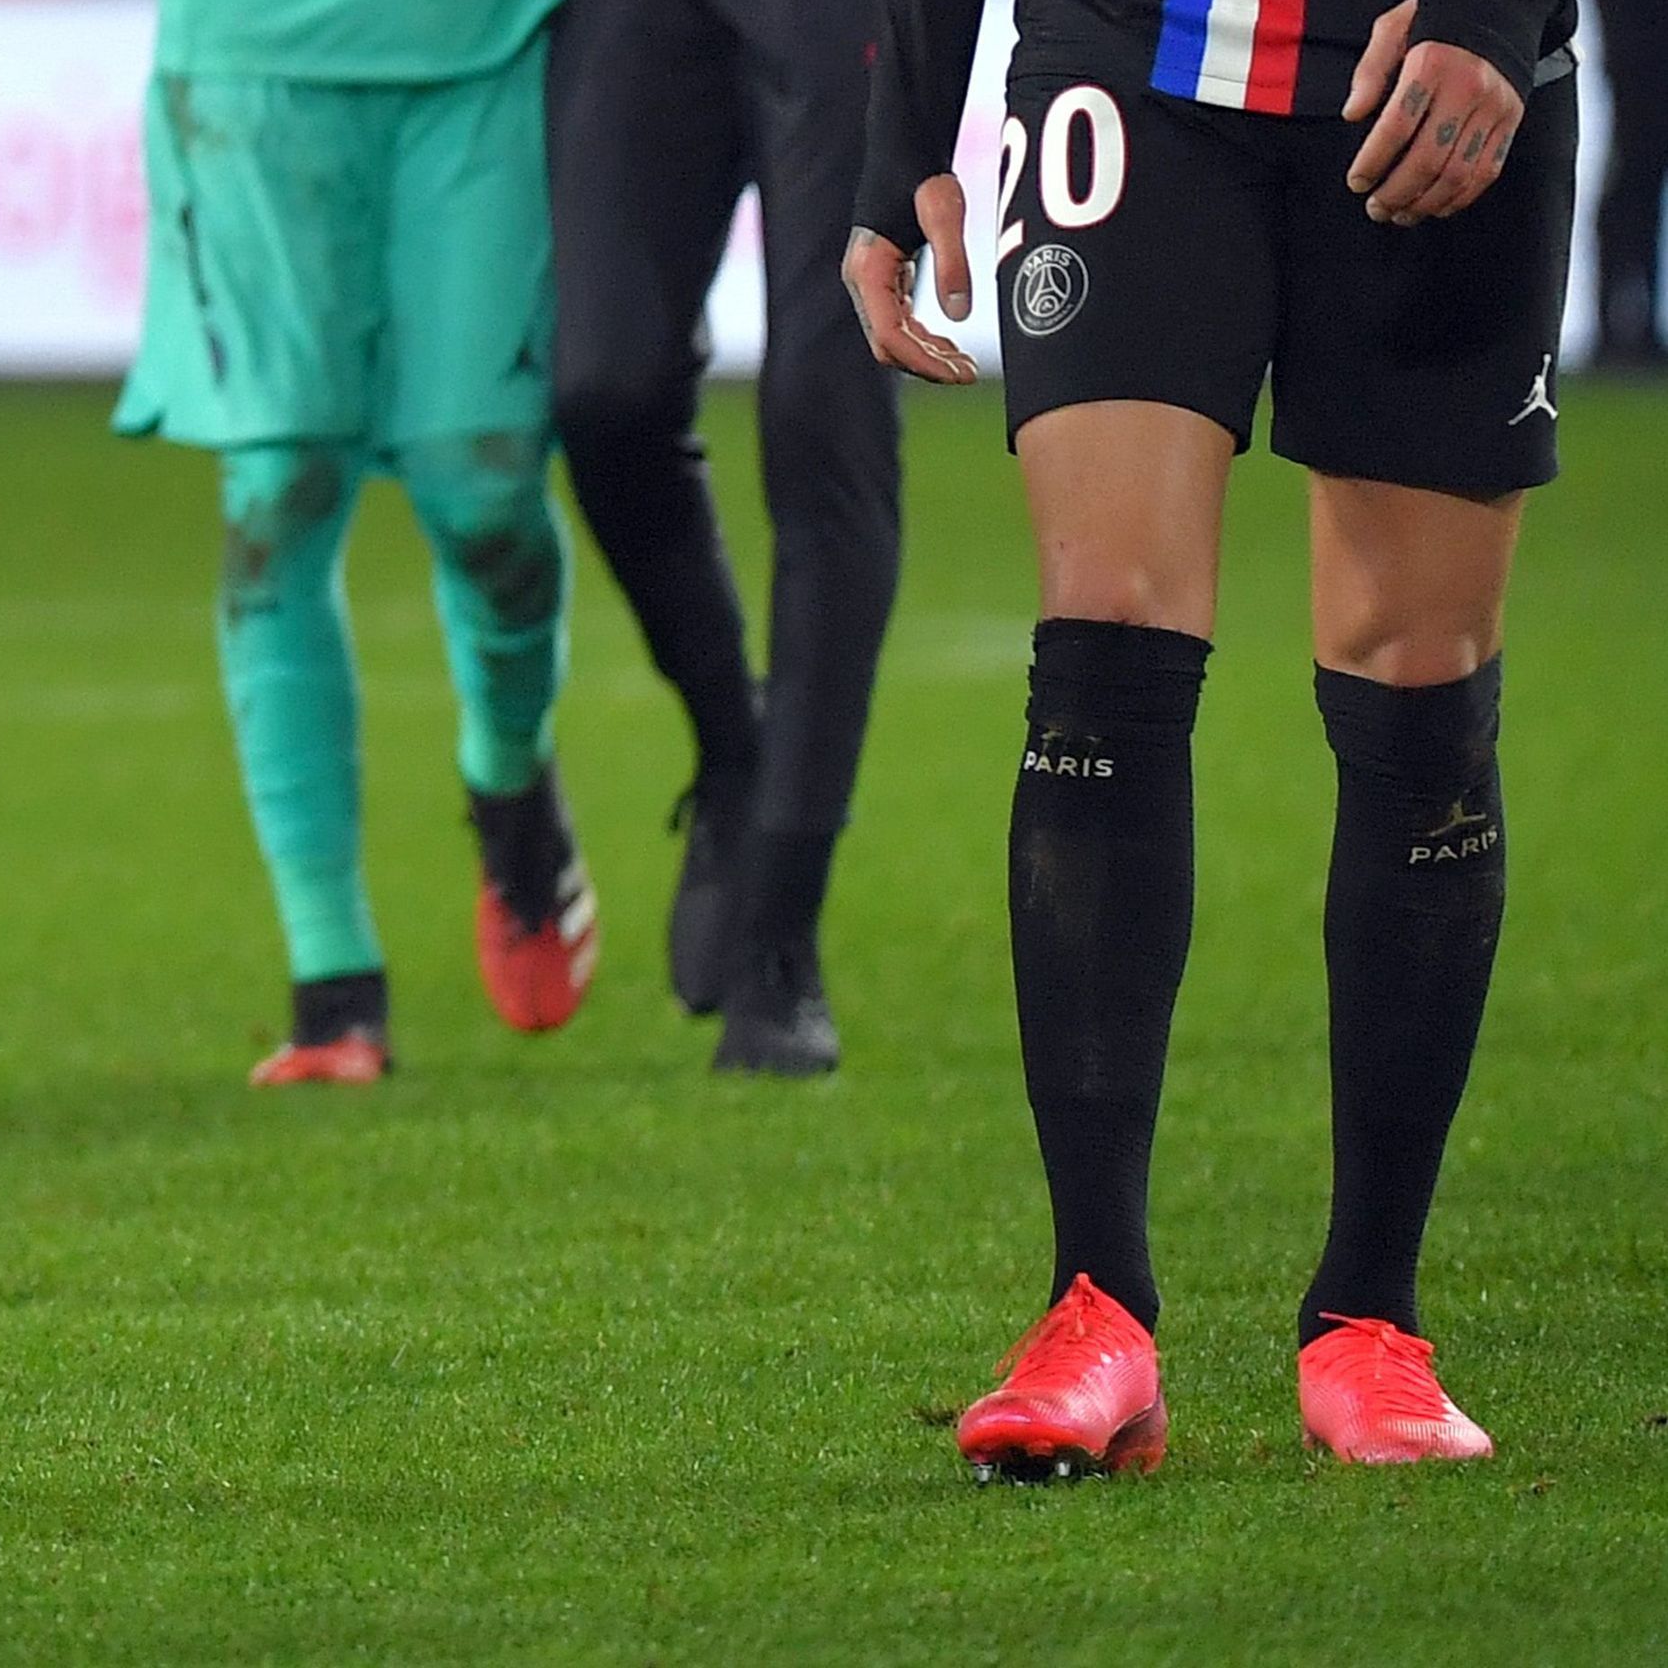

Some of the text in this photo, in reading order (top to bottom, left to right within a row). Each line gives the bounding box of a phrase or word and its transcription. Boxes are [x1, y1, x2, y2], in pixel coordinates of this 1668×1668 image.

[996, 83, 1130, 265] 20
[1022, 248, 1073, 277] PARIS
[1024, 750, 1115, 778] PARIS
[1408, 824, 1498, 865] PARIS
